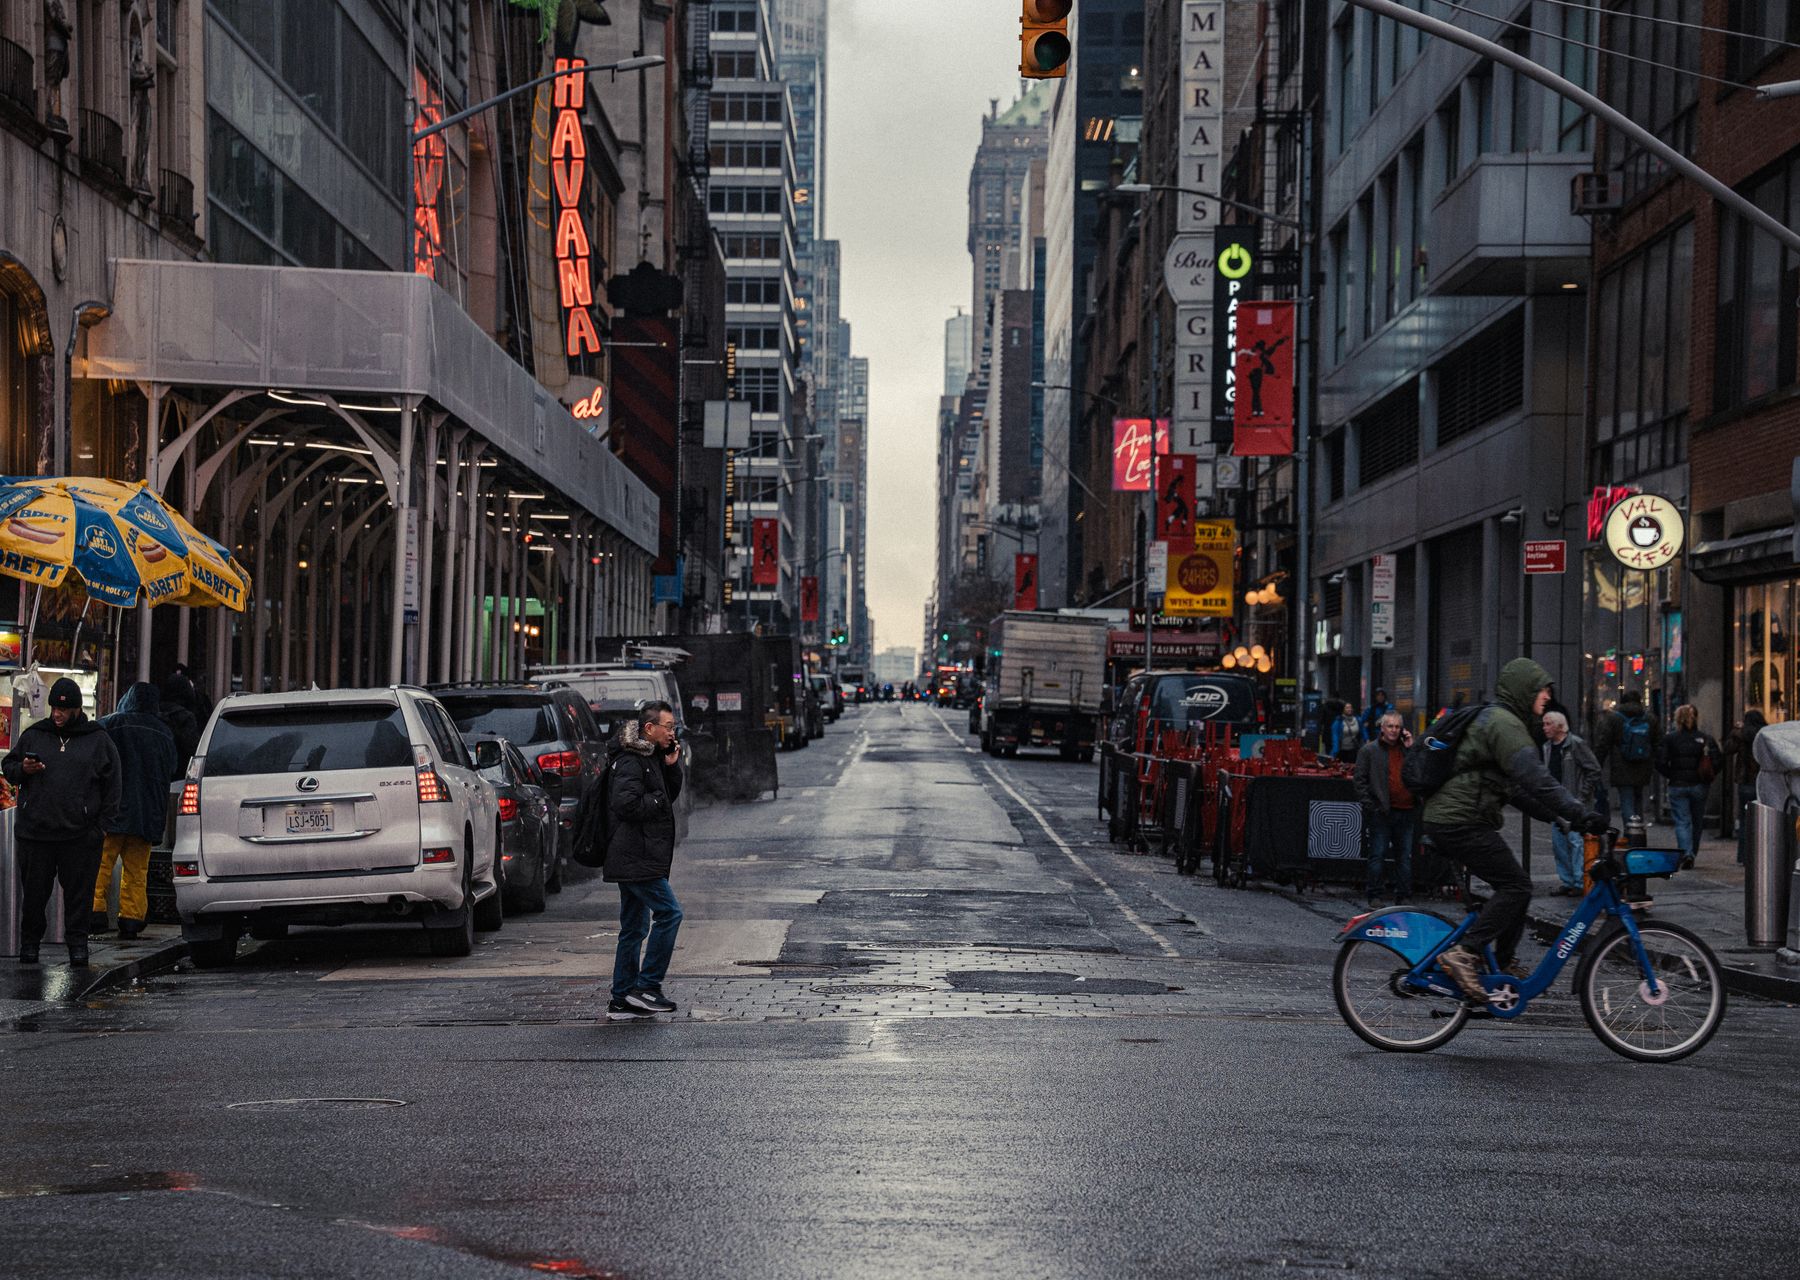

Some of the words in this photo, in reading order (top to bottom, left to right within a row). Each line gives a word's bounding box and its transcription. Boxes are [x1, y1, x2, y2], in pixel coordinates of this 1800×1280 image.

[1190, 11, 1216, 220] MARAIS
[552, 57, 600, 356] HAVANA
[1190, 274, 1206, 287] &
[1620, 498, 1663, 521] VAL
[1535, 543, 1560, 552] STANDING
[1617, 542, 1674, 567] CAFE
[1526, 552, 1548, 560] Anytime
[192, 562, 240, 603] SABRETT
[1182, 567, 1217, 586] 24HRS
[105, 585, 121, 595] ROLL
[1202, 598, 1227, 608] BEER
[1135, 645, 1194, 655] RETAURANT
